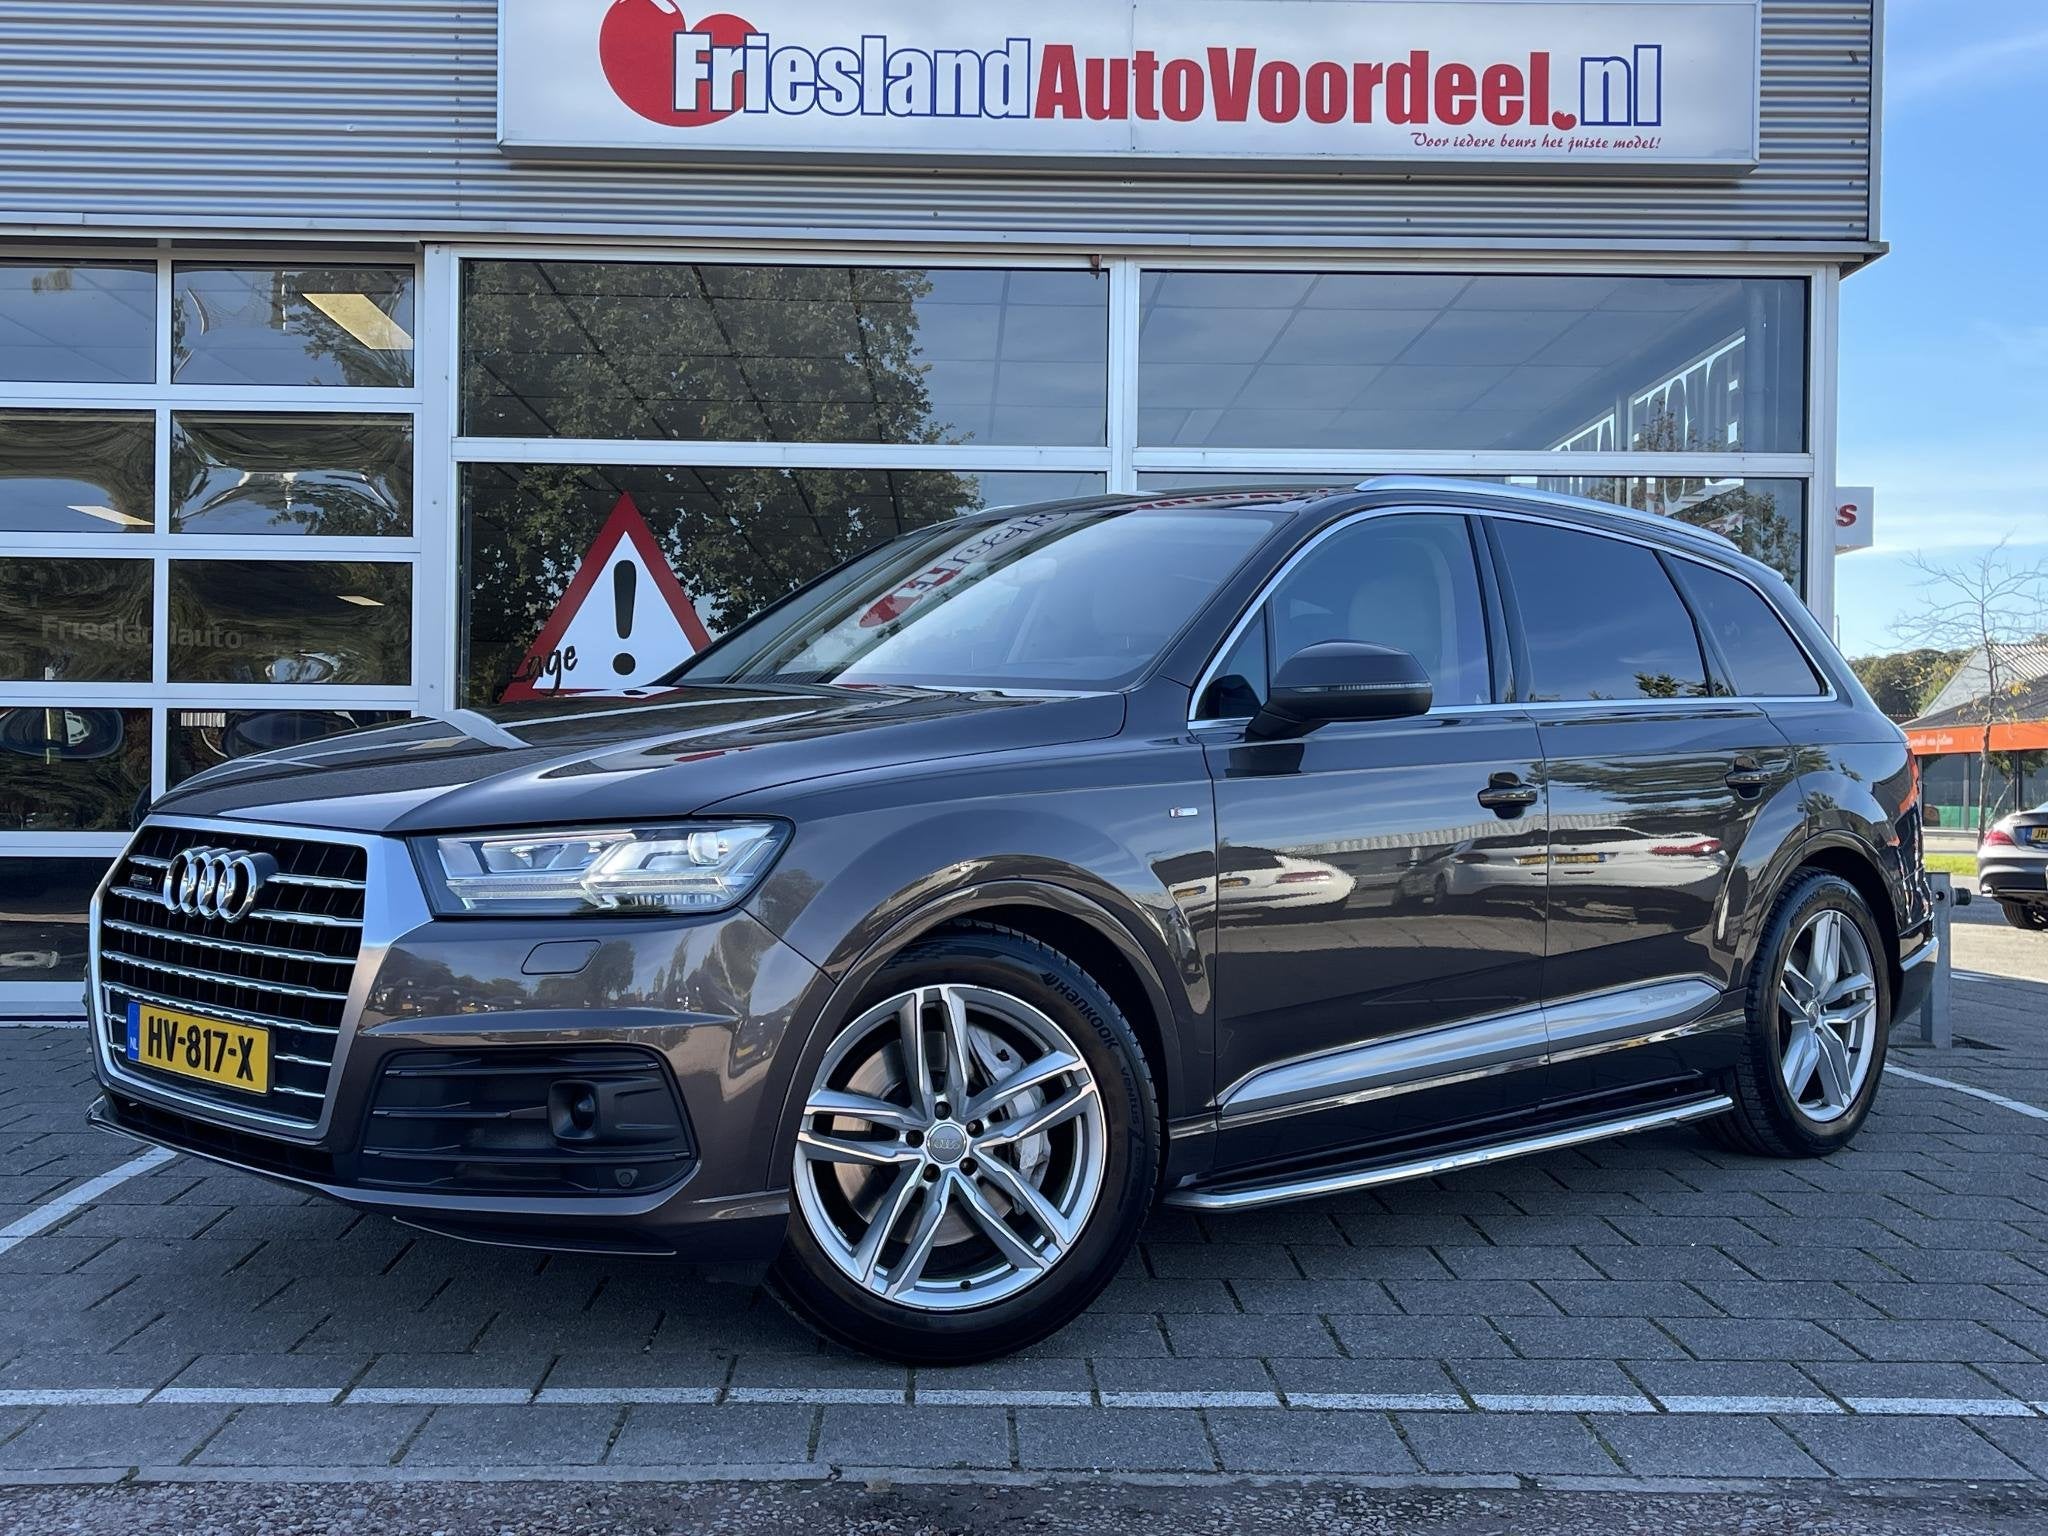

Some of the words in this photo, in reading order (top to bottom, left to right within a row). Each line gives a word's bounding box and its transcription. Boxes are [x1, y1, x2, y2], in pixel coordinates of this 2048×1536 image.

[1411, 132, 1449, 147] Voor
[1454, 134, 1495, 148] iedere
[1500, 133, 1537, 149] beurs
[1542, 133, 1563, 149] het
[1567, 136, 1608, 152] juiste
[1613, 135, 1661, 149] model!
[513, 645, 578, 696] age
[129, 1037, 138, 1050] NL
[148, 1015, 254, 1082] HV-817-X
